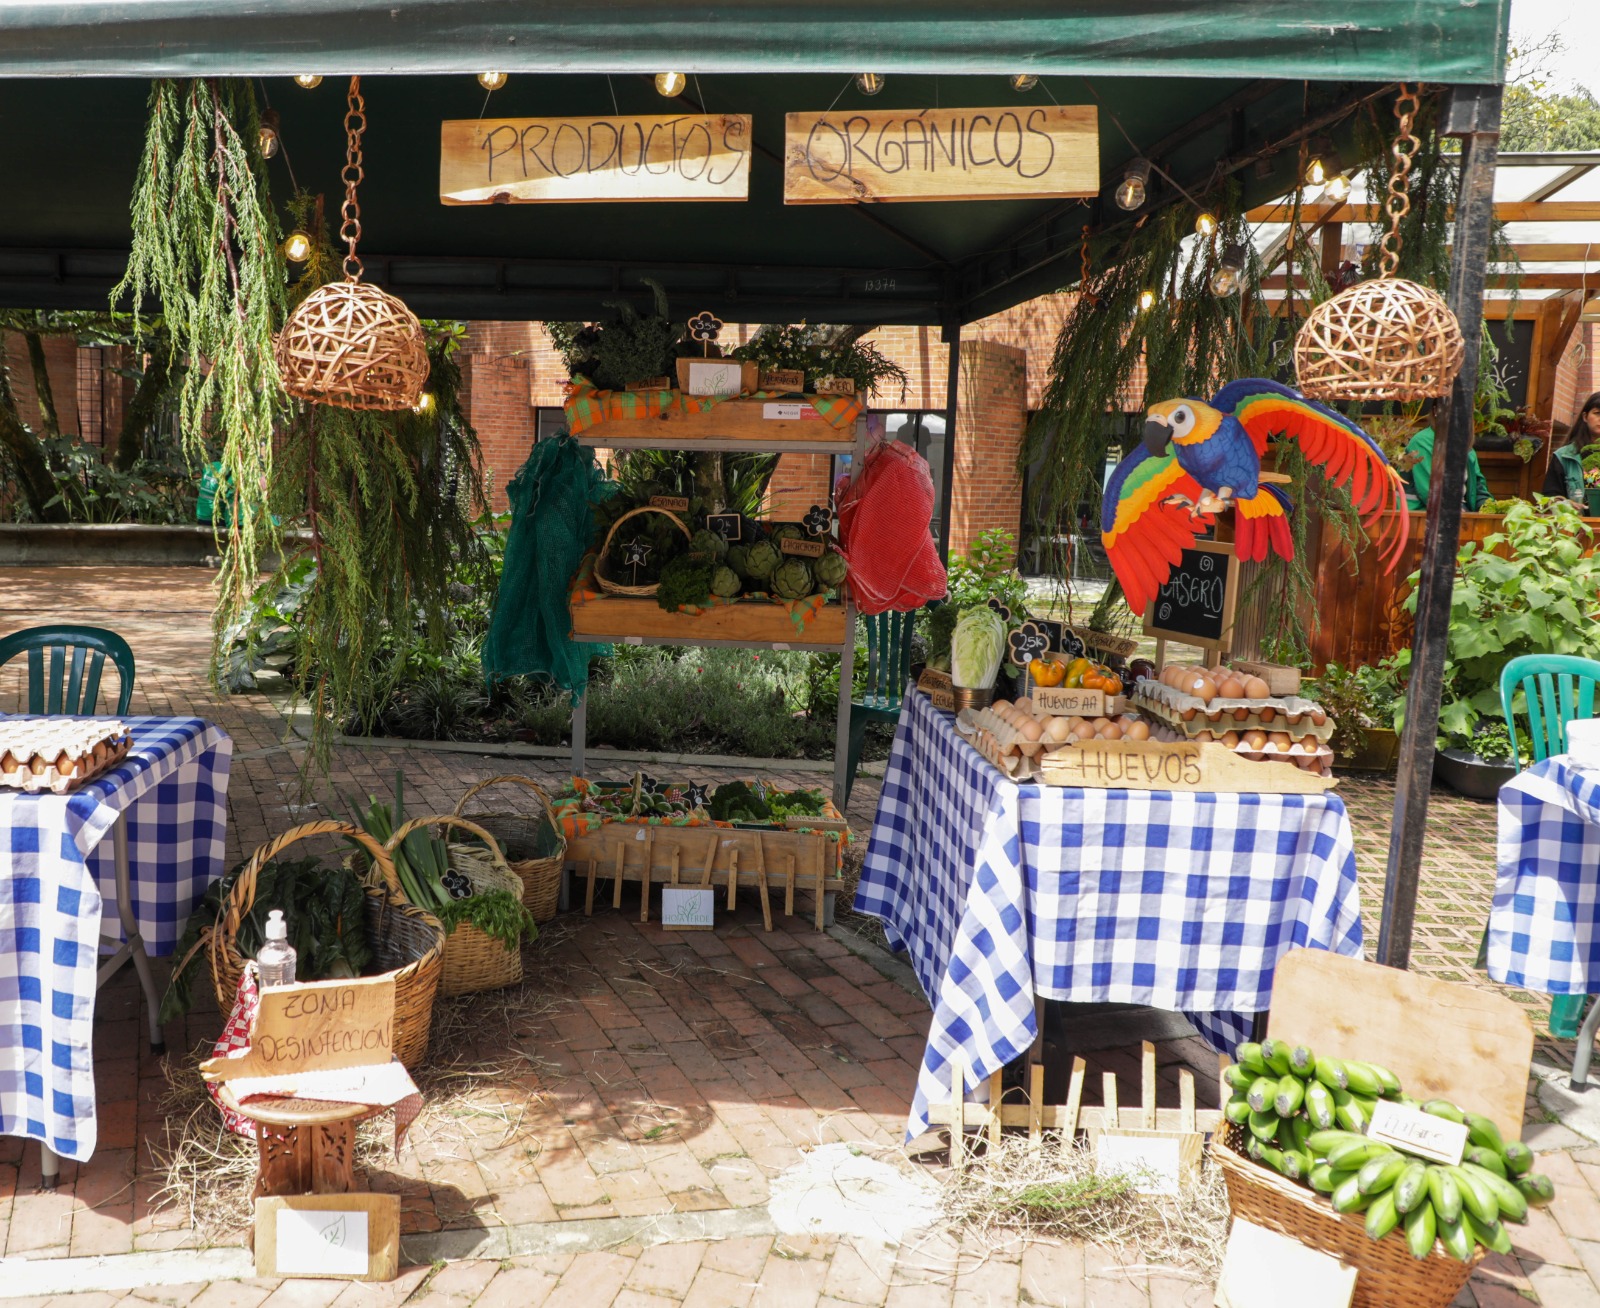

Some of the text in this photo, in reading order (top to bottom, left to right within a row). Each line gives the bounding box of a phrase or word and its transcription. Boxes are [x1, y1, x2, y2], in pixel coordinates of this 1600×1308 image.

[482, 108, 1055, 184] PRODUCTOS ORGÁNICOS
[1039, 693, 1079, 710] HUEVOS
[1077, 748, 1201, 785] HUEVOS
[282, 989, 356, 1019] ZONA
[258, 1017, 393, 1062] DESINFECCIÓN
